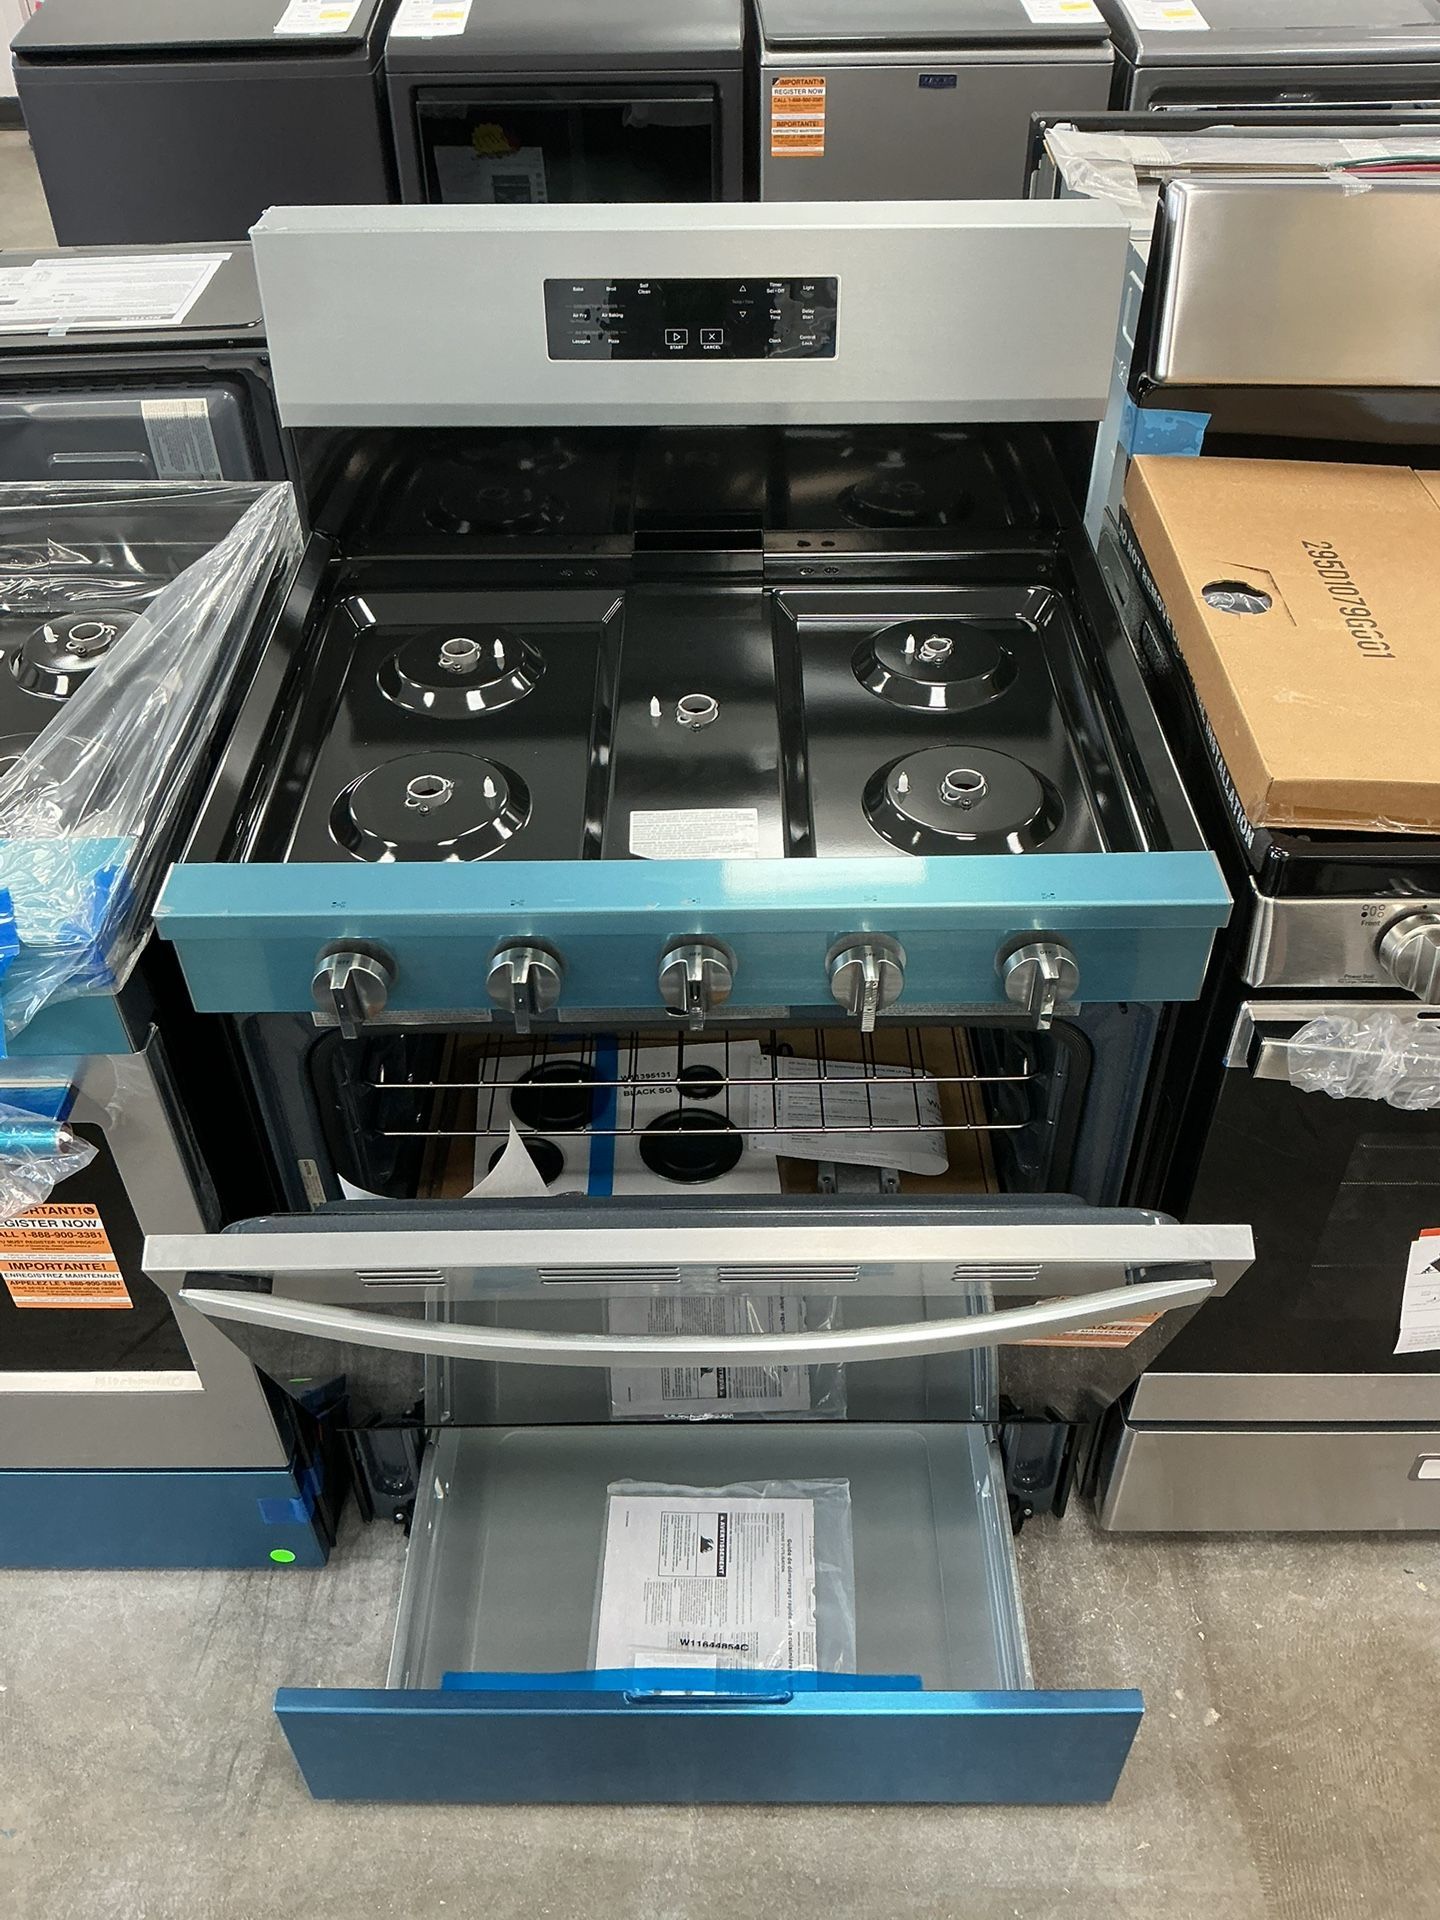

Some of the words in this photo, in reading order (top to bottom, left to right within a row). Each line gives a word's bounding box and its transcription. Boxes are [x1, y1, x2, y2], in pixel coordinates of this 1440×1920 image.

[1127, 539, 1142, 572] NOT
[623, 1088, 657, 1097] BLACK
[658, 1087, 673, 1095] SG
[61, 1219, 97, 1228] NOW
[21, 1231, 103, 1239] 1-888-900-3381
[8, 1262, 107, 1271] IMPORTANTE!
[787, 1557, 792, 1565] de
